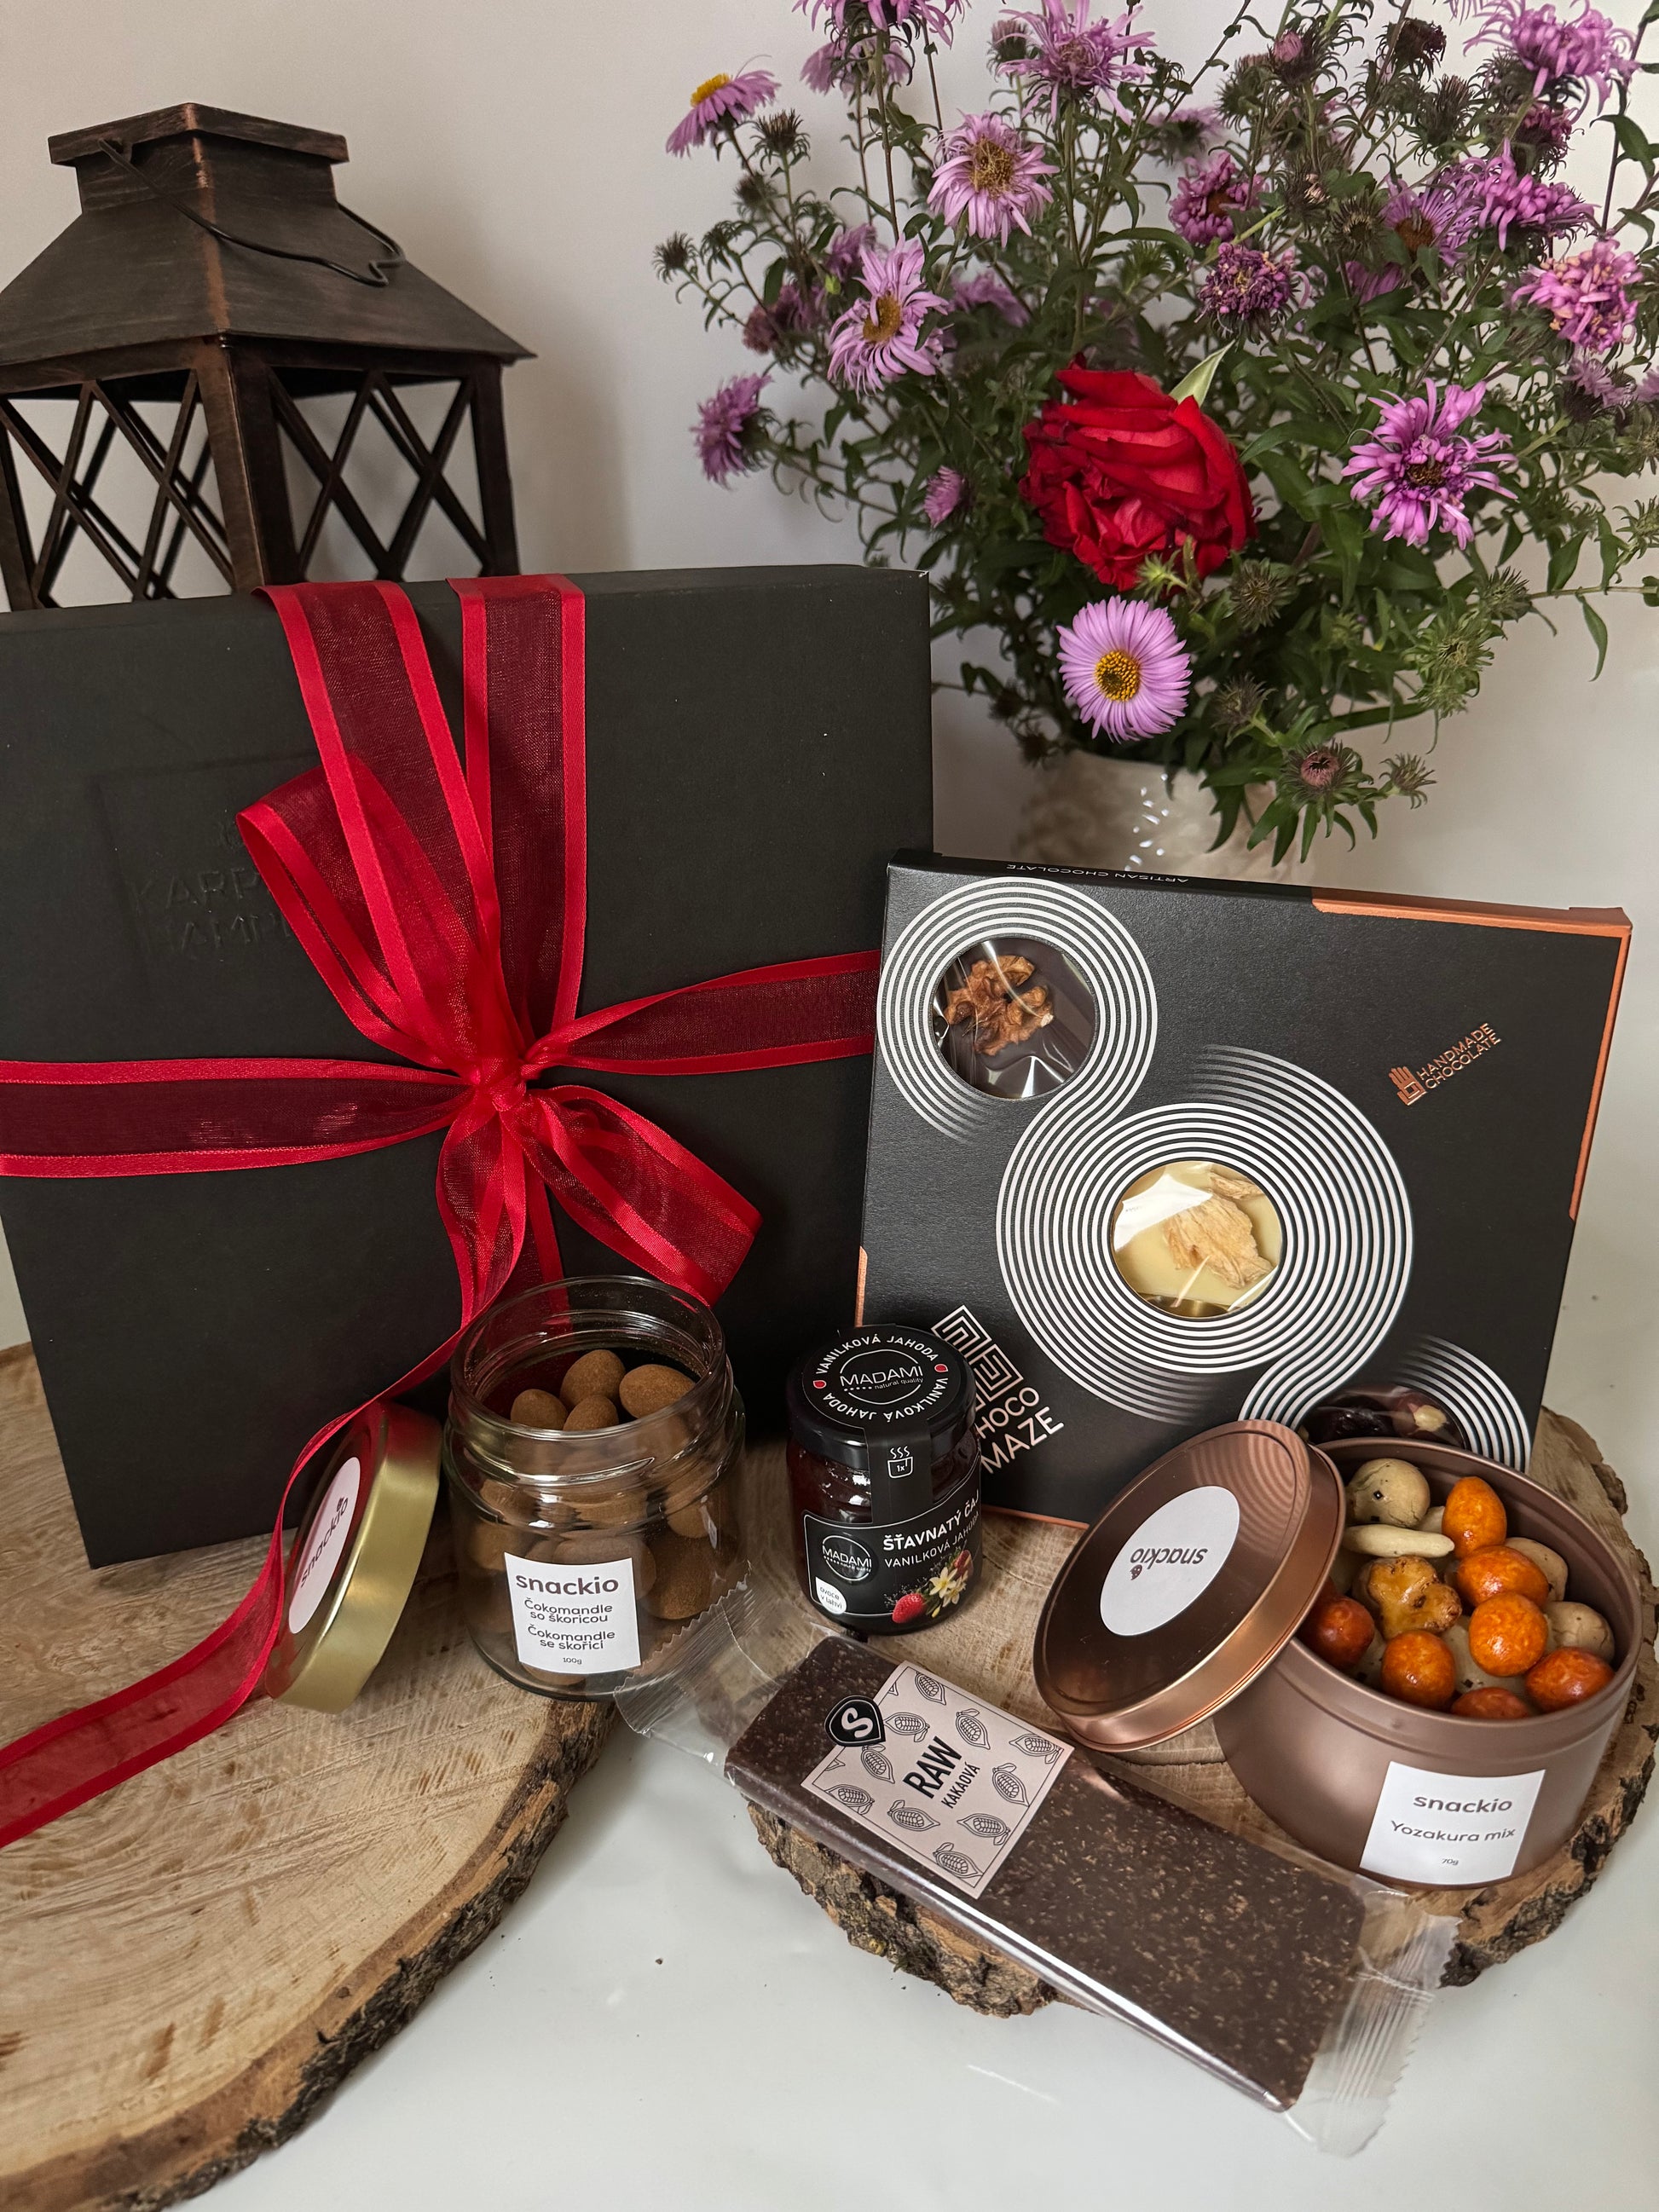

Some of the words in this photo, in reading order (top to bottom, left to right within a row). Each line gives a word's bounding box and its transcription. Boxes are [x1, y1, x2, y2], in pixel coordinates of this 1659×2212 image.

[1006, 863, 1109, 877] CHOCOLATE
[1114, 872, 1189, 884] ARTISAN
[1416, 1022, 1494, 1081] HANDMADE
[1425, 1032, 1501, 1089] CHOCOLATE
[816, 1333, 882, 1375] VANILKOVÁ
[886, 1335, 939, 1361] JAHODA
[840, 1366, 923, 1387] MADAMI
[874, 1379, 899, 1389] natural
[900, 1377, 924, 1385] quality
[823, 1392, 877, 1421] JAHODA
[882, 1377, 949, 1423] VANILKOVÁ
[974, 1387, 1040, 1440] HOCO
[980, 1406, 1065, 1475] MAZE
[896, 1464, 905, 1473] 1x
[882, 1509, 962, 1551] ŠŤAVNATÝ
[964, 1488, 980, 1518] ČAJ
[300, 1497, 350, 1589] snackio
[884, 1539, 951, 1568] VANILKOVÁ
[822, 1545, 872, 1568] MADAMI
[1130, 1547, 1209, 1570] snackio
[515, 1574, 619, 1596] snackio
[523, 1597, 613, 1615] Čokomandle
[529, 1610, 546, 1621] so
[548, 1613, 608, 1624] škoricou
[527, 1623, 616, 1642] Čokomandle
[540, 1638, 555, 1649] se
[562, 1656, 582, 1666] 100g
[841, 1707, 874, 1739] S
[902, 1736, 962, 1799] RAW
[940, 1761, 981, 1810] KAKAOVÁ
[1413, 1795, 1513, 1814] snackio
[1390, 1820, 1480, 1842] Yozakura
[1483, 1828, 1516, 1842] mix
[1441, 1857, 1460, 1866] 70g
